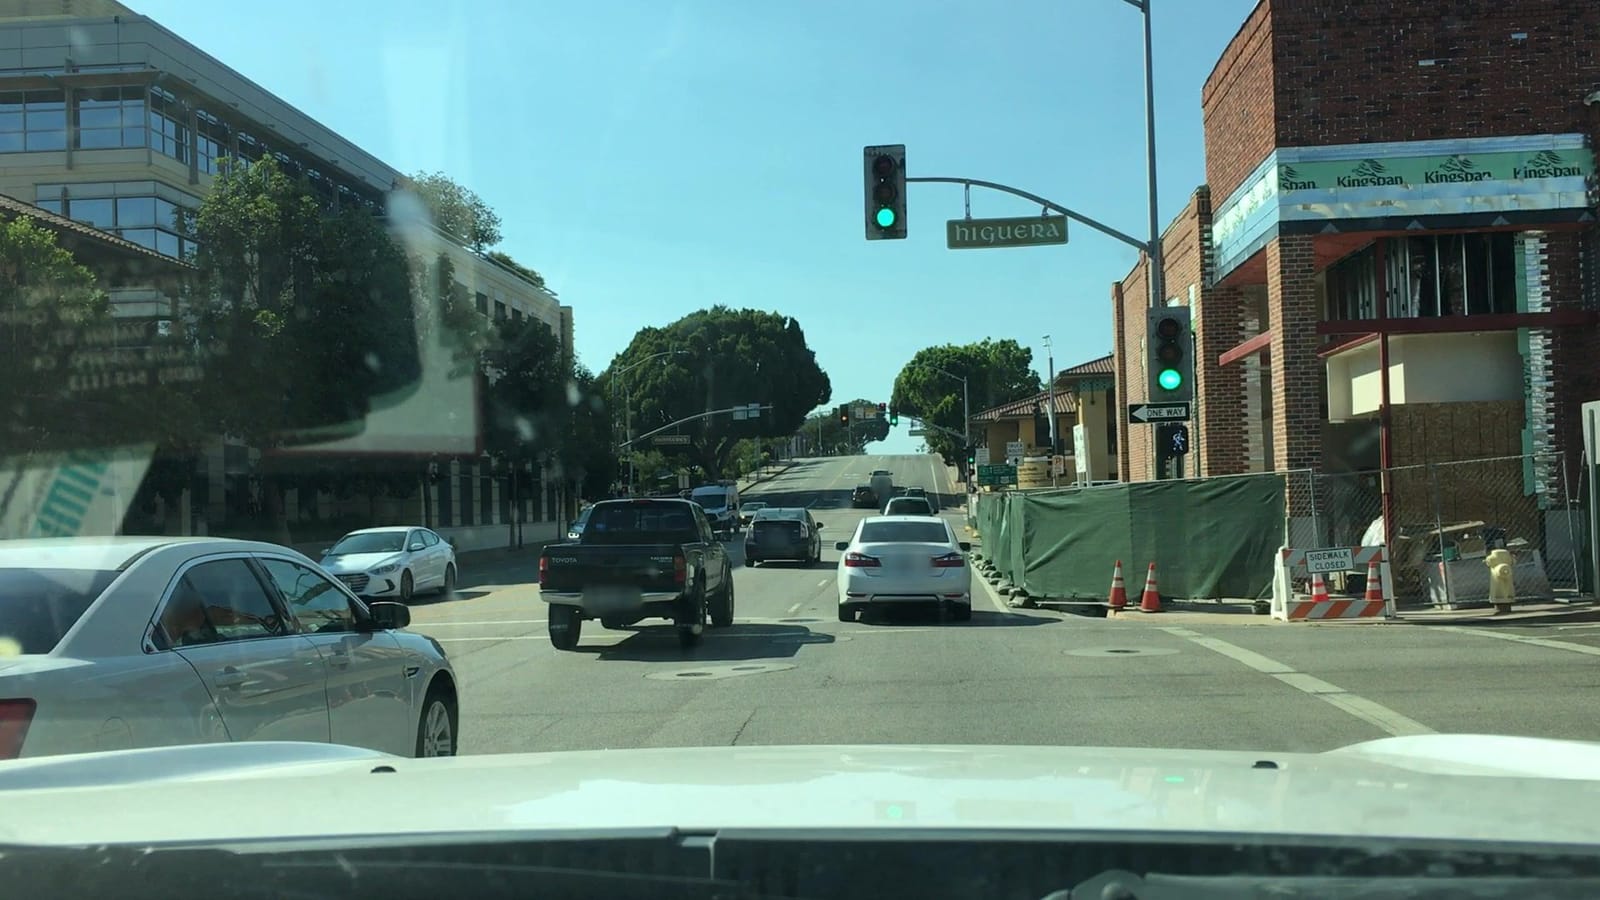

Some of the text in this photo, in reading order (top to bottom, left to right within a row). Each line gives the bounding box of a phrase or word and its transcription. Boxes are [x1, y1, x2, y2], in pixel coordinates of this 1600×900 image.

[955, 223, 1060, 243] HIGUERA
[1146, 408, 1184, 417] ONE WAY
[551, 556, 578, 564] TOYOTA
[1309, 550, 1350, 561] SIDEWALK
[1314, 560, 1347, 570] CLOSED
